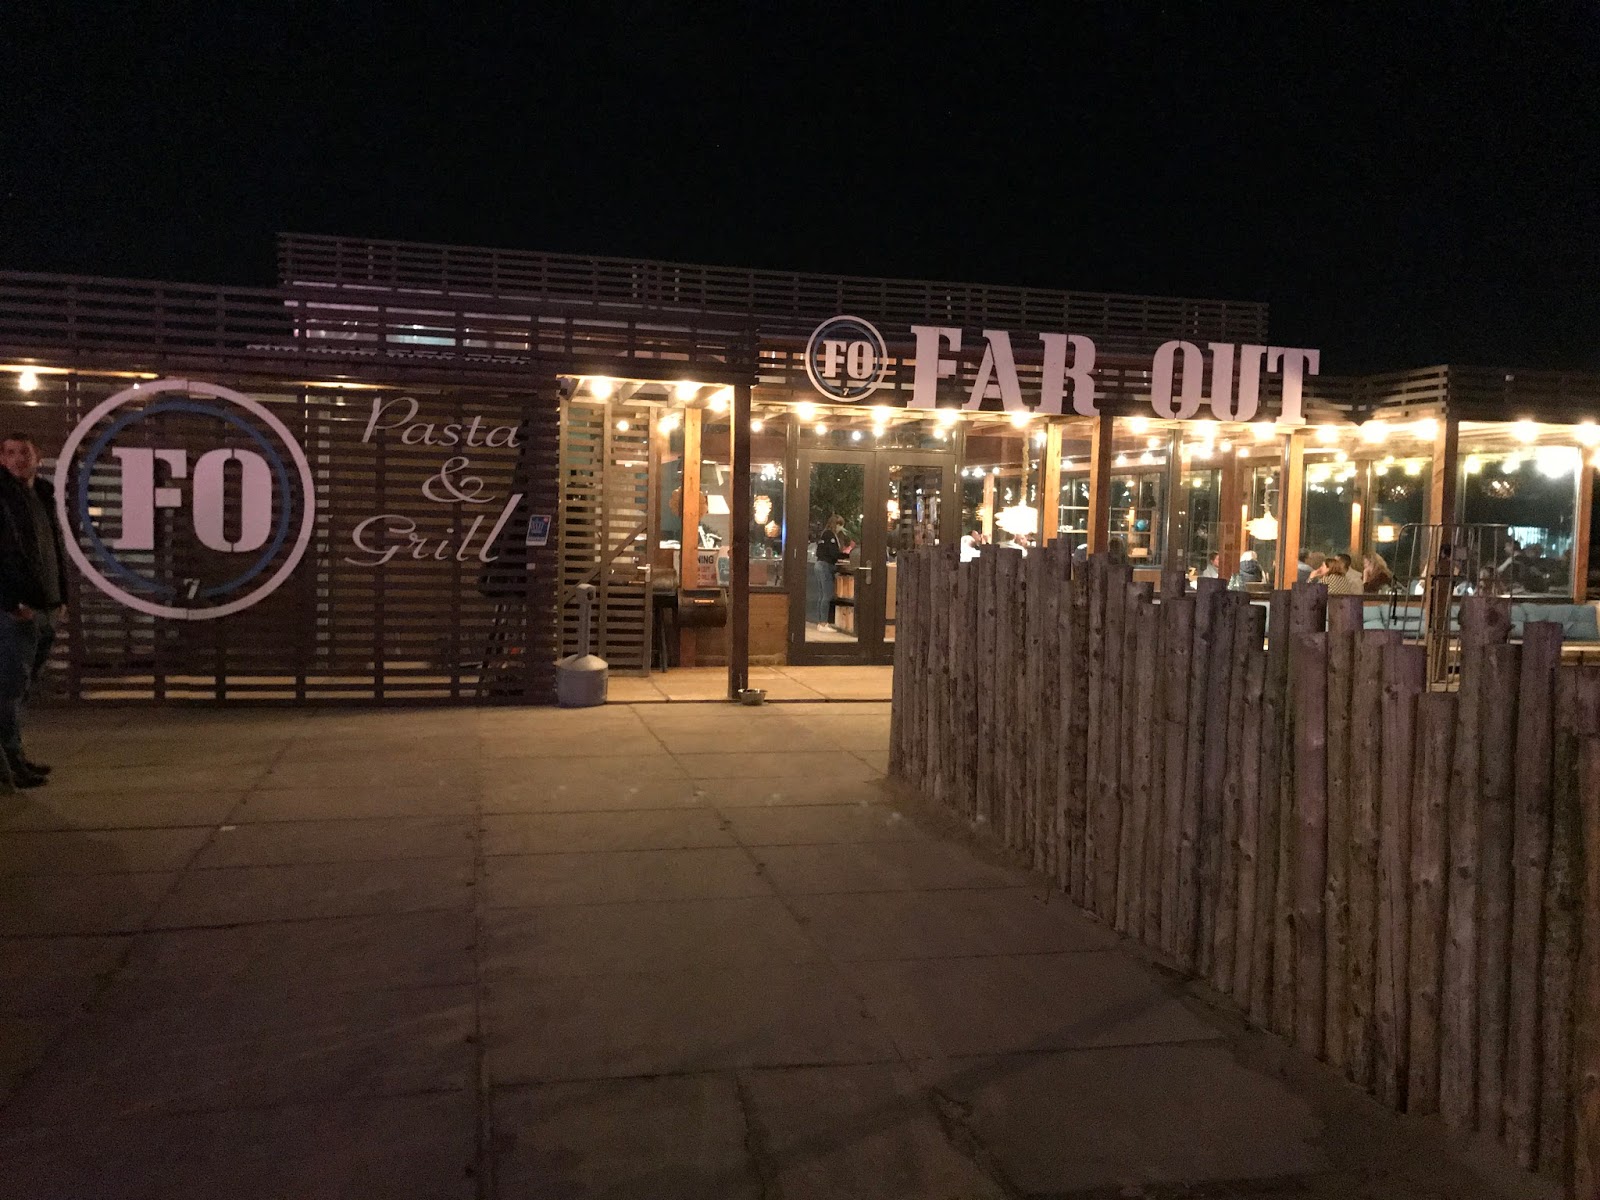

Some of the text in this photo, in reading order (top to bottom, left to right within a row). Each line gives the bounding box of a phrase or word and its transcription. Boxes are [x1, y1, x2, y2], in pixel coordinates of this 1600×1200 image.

[821, 340, 875, 379] FO
[906, 325, 1320, 425] FAR OUT
[842, 387, 850, 396] 7
[362, 396, 521, 448] Pasta
[112, 448, 272, 552] FO
[421, 456, 496, 503] &
[344, 493, 524, 567] Grill
[183, 578, 200, 600] 7
